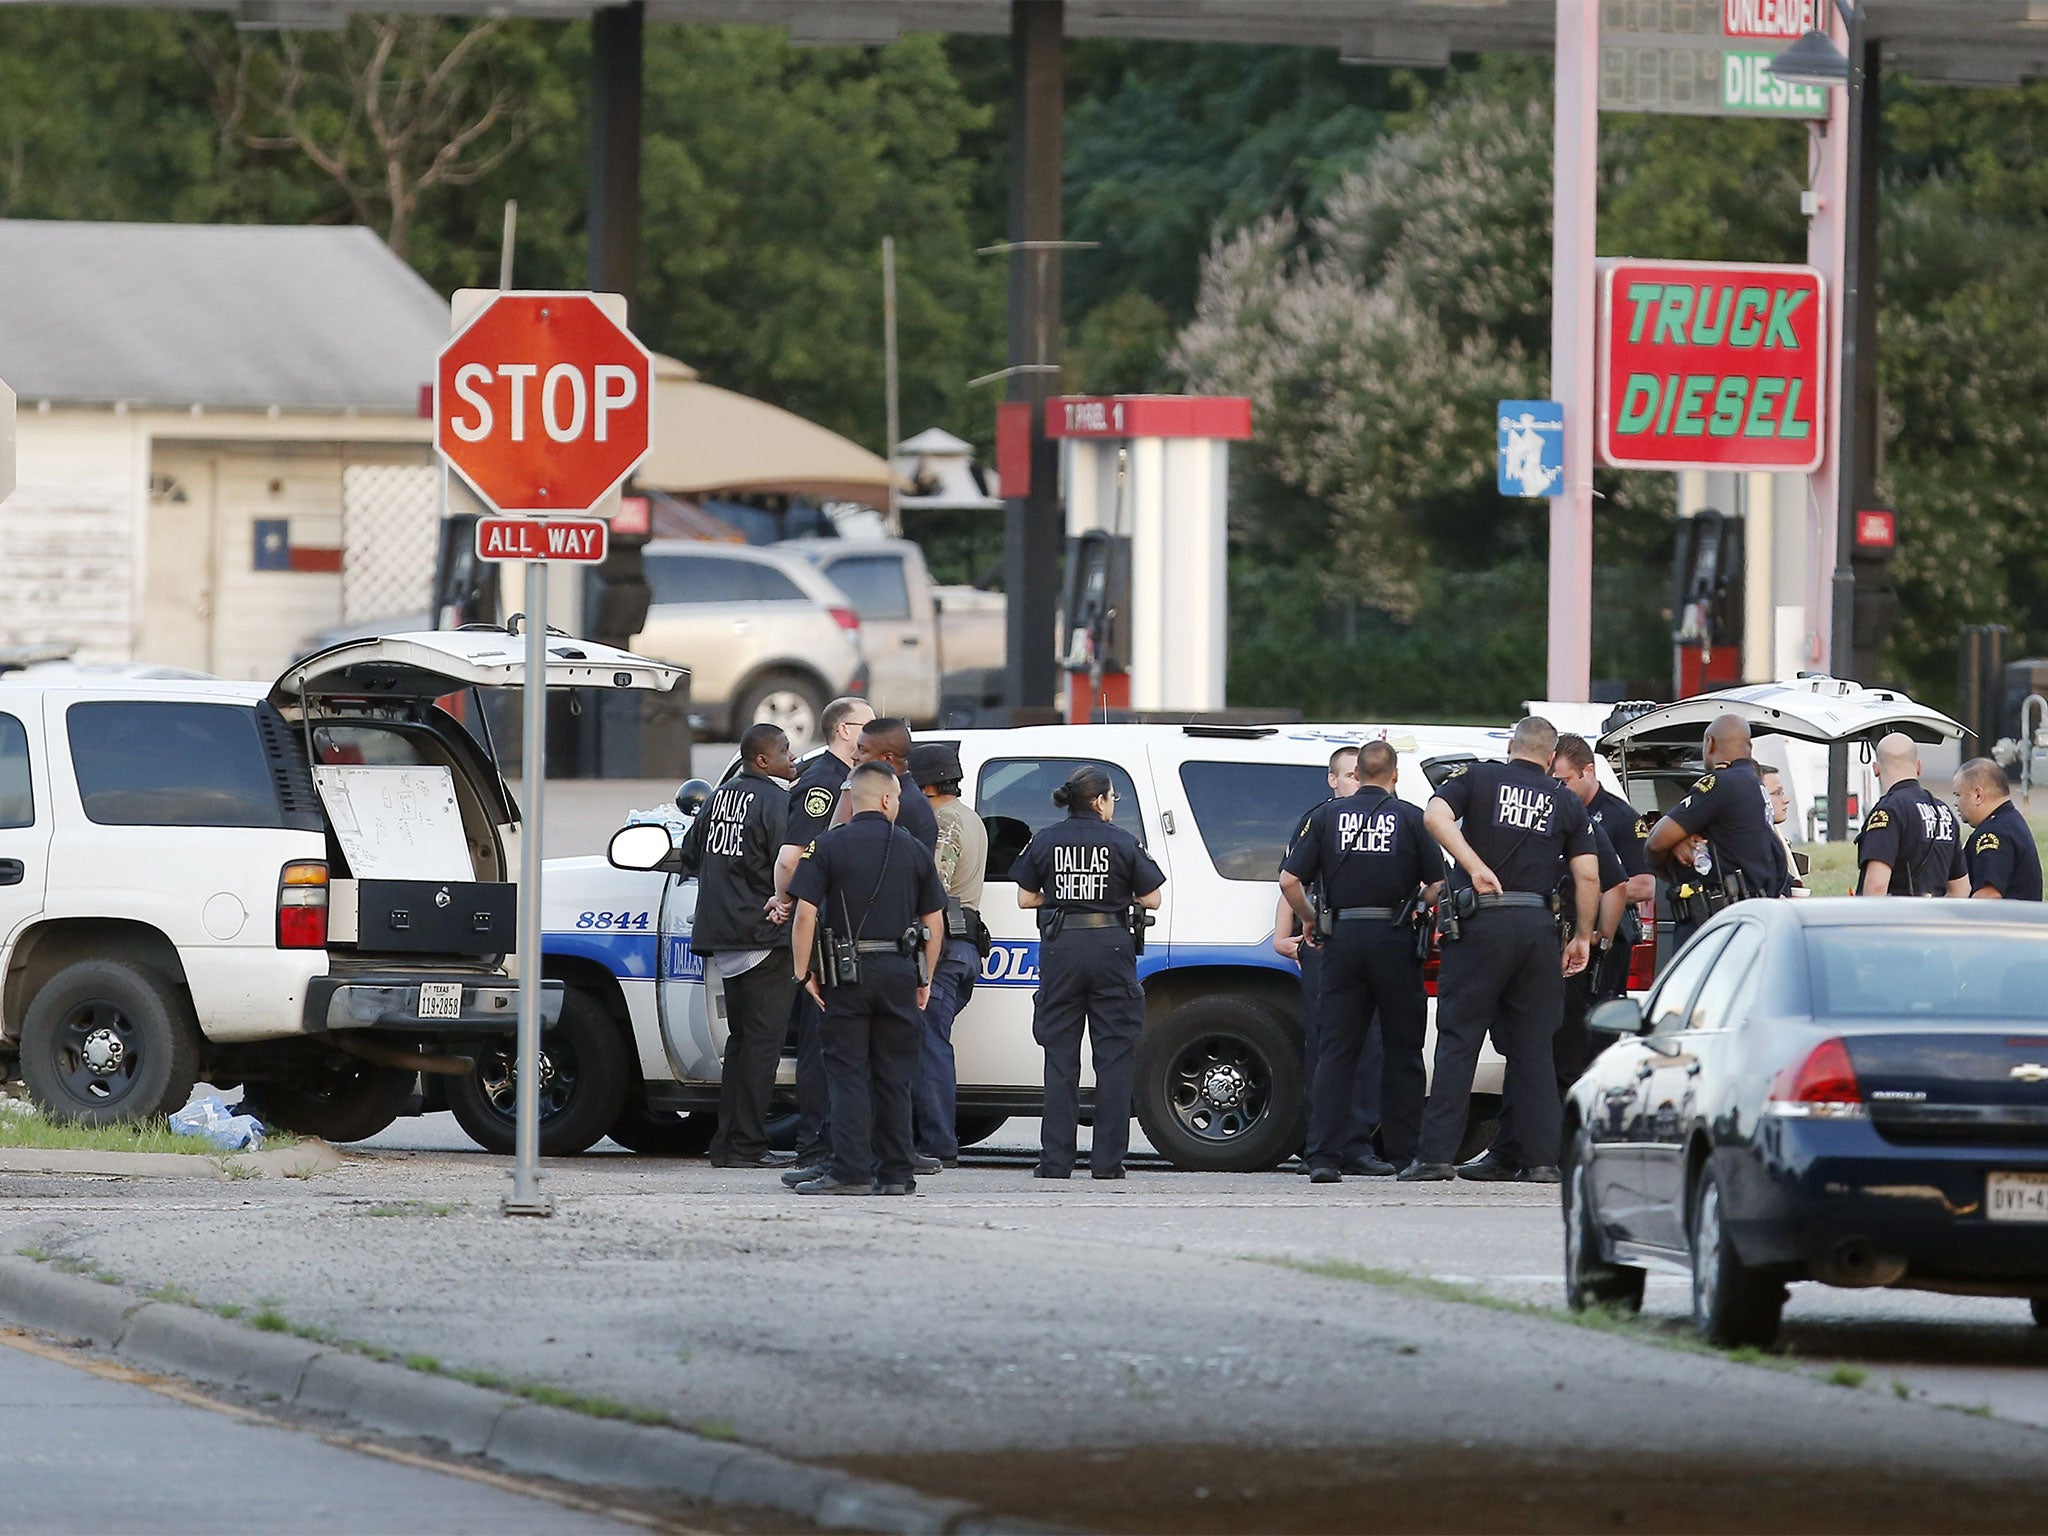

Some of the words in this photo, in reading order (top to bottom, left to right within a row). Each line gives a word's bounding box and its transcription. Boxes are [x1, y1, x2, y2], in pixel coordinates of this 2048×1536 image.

[1628, 283, 1811, 348] TRUCK
[451, 363, 637, 442] STOP
[1616, 373, 1811, 439] DIESEL
[488, 527, 532, 552] ALL
[548, 528, 596, 554] WAY
[711, 789, 755, 823] DALLAS
[1499, 785, 1554, 816] DALLAS
[1338, 812, 1396, 833] DALLAS
[1499, 804, 1548, 832] POLICE
[1341, 831, 1391, 852] POLICE
[1054, 846, 1109, 873] DALLAS
[1055, 873, 1109, 900] SHERIFF
[575, 911, 649, 930] 8844
[433, 985, 449, 993] TEXAS
